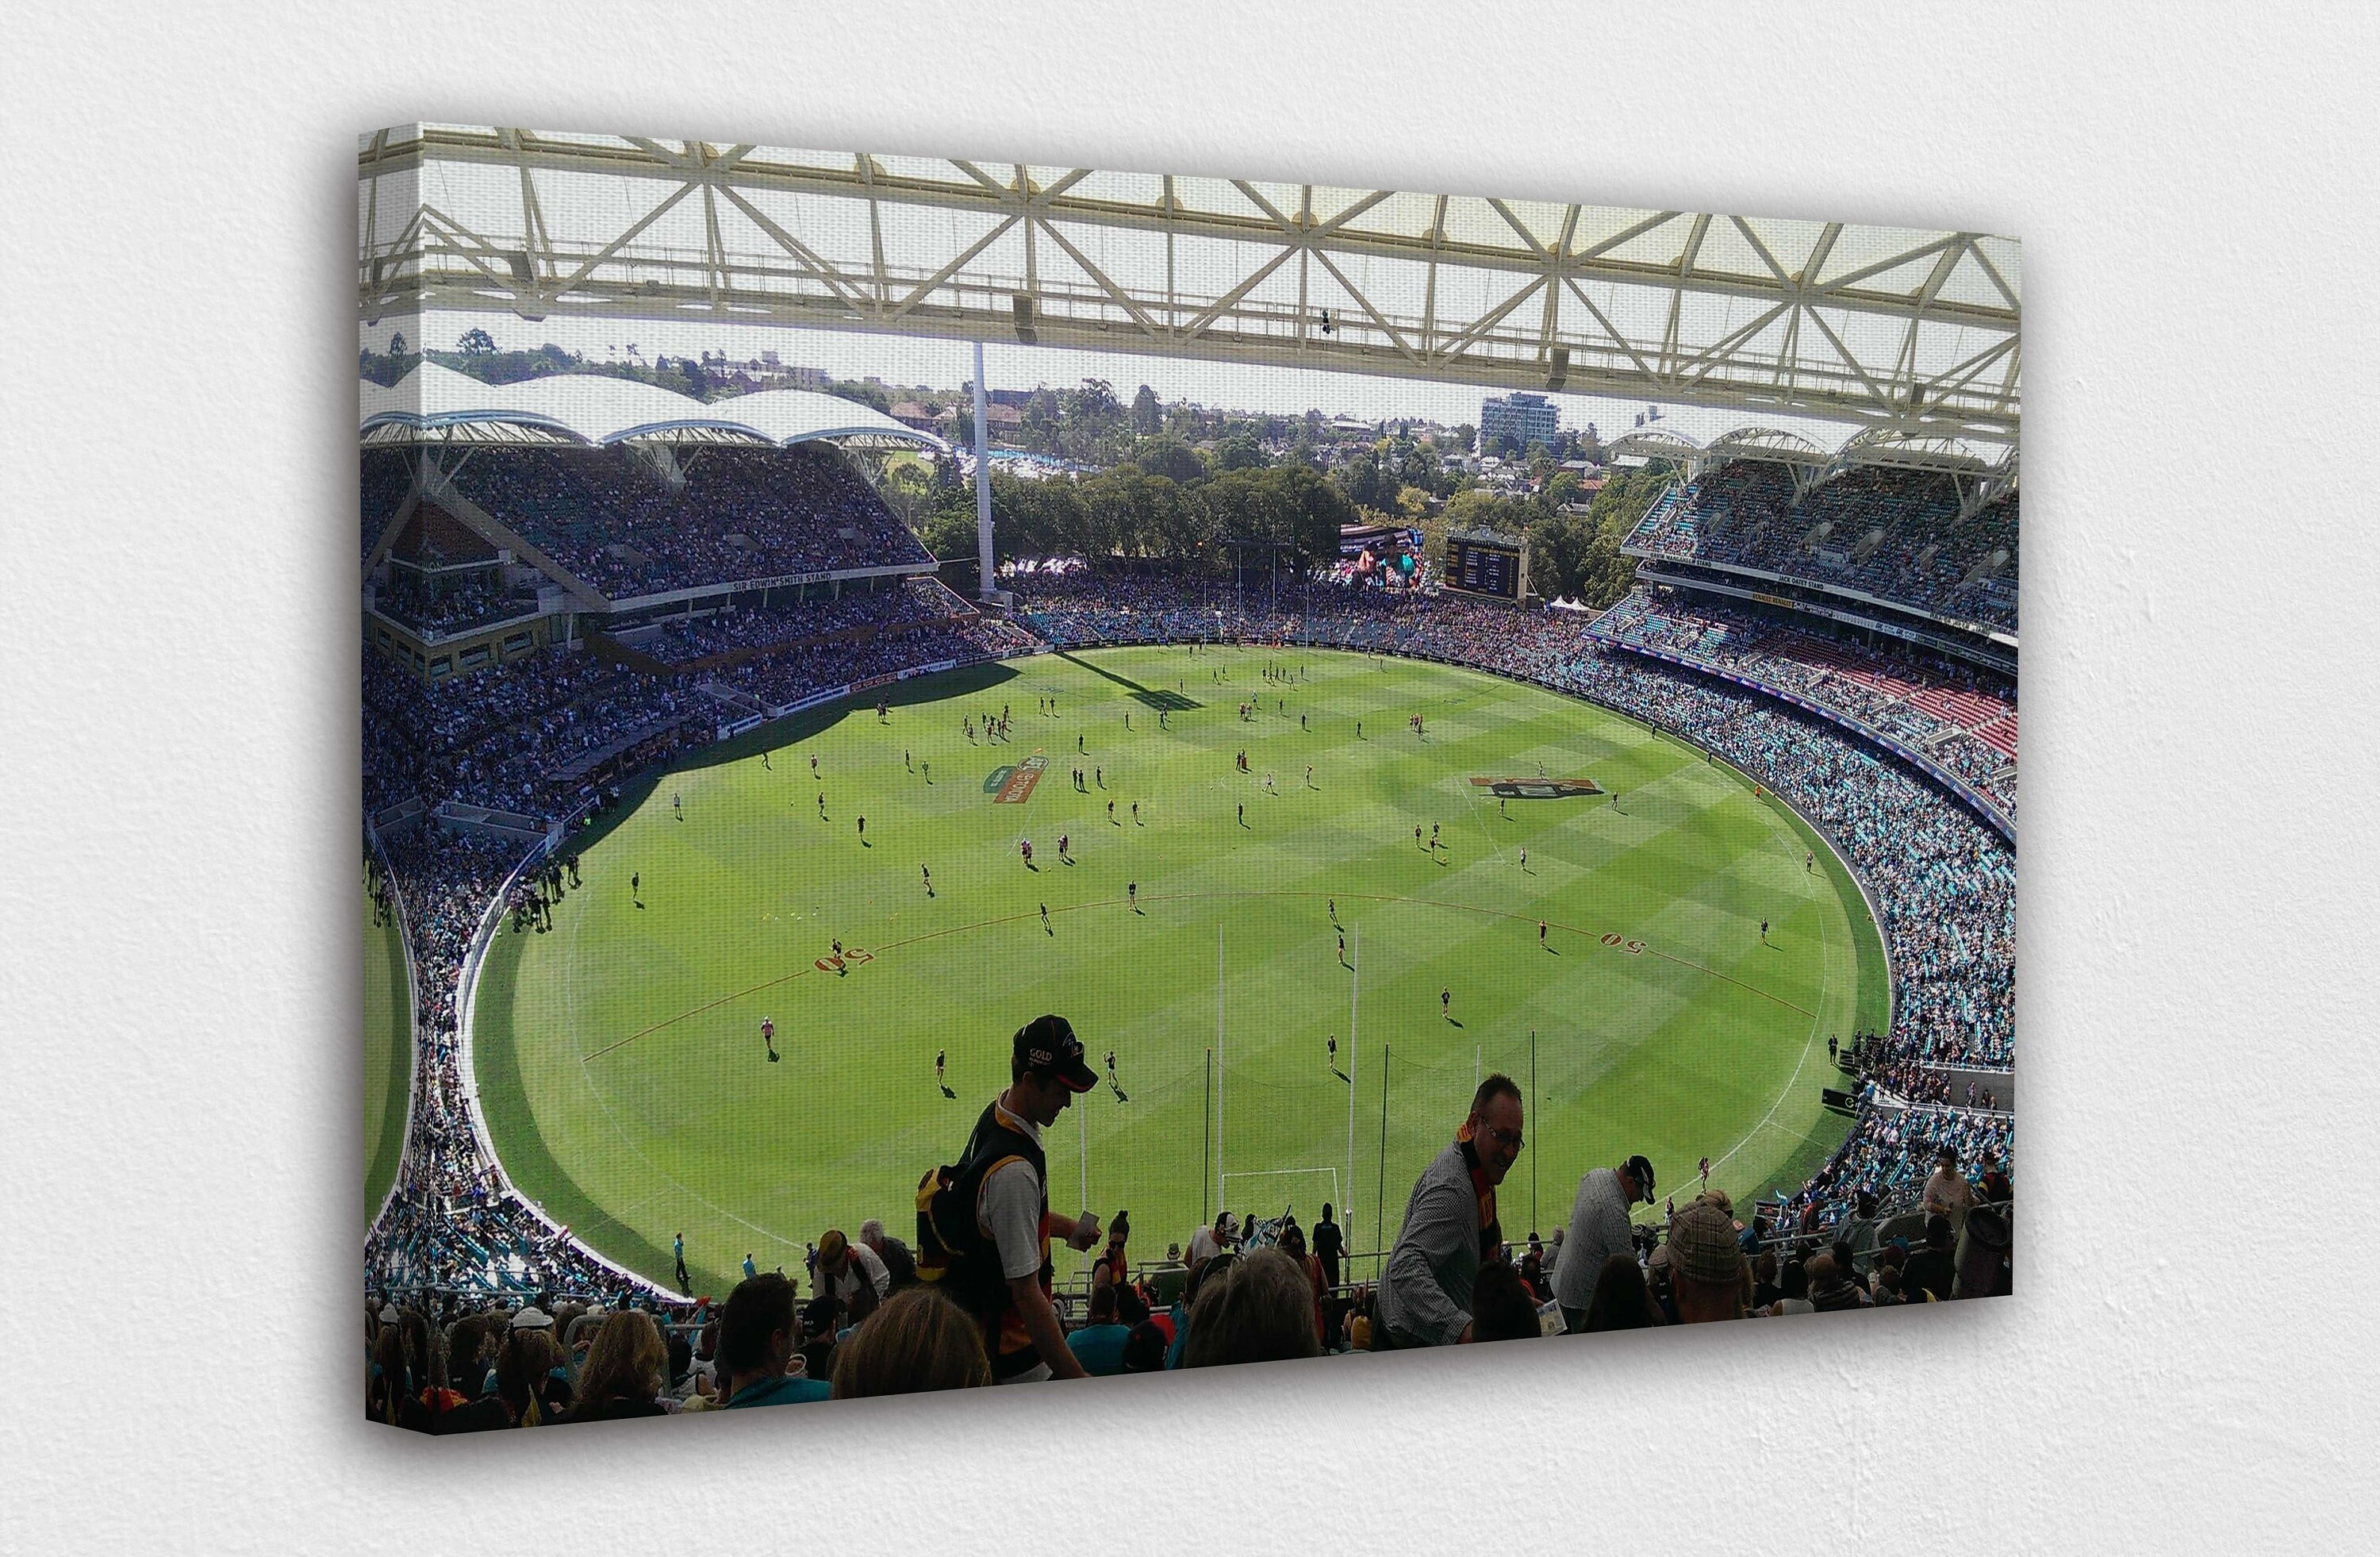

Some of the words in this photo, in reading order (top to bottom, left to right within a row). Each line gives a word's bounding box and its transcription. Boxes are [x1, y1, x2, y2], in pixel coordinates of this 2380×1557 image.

[1696, 559, 1712, 567] STAND
[733, 581, 747, 591] SIR
[750, 578, 777, 589] EDWIN
[778, 575, 804, 586] SMITH
[805, 571, 831, 582] STAND
[1779, 575, 1791, 583] JACK
[1792, 578, 1808, 587] OATEY
[1809, 581, 1824, 590] STAND
[1600, 932, 1649, 955] 50
[1031, 1048, 1052, 1061] GOLD
